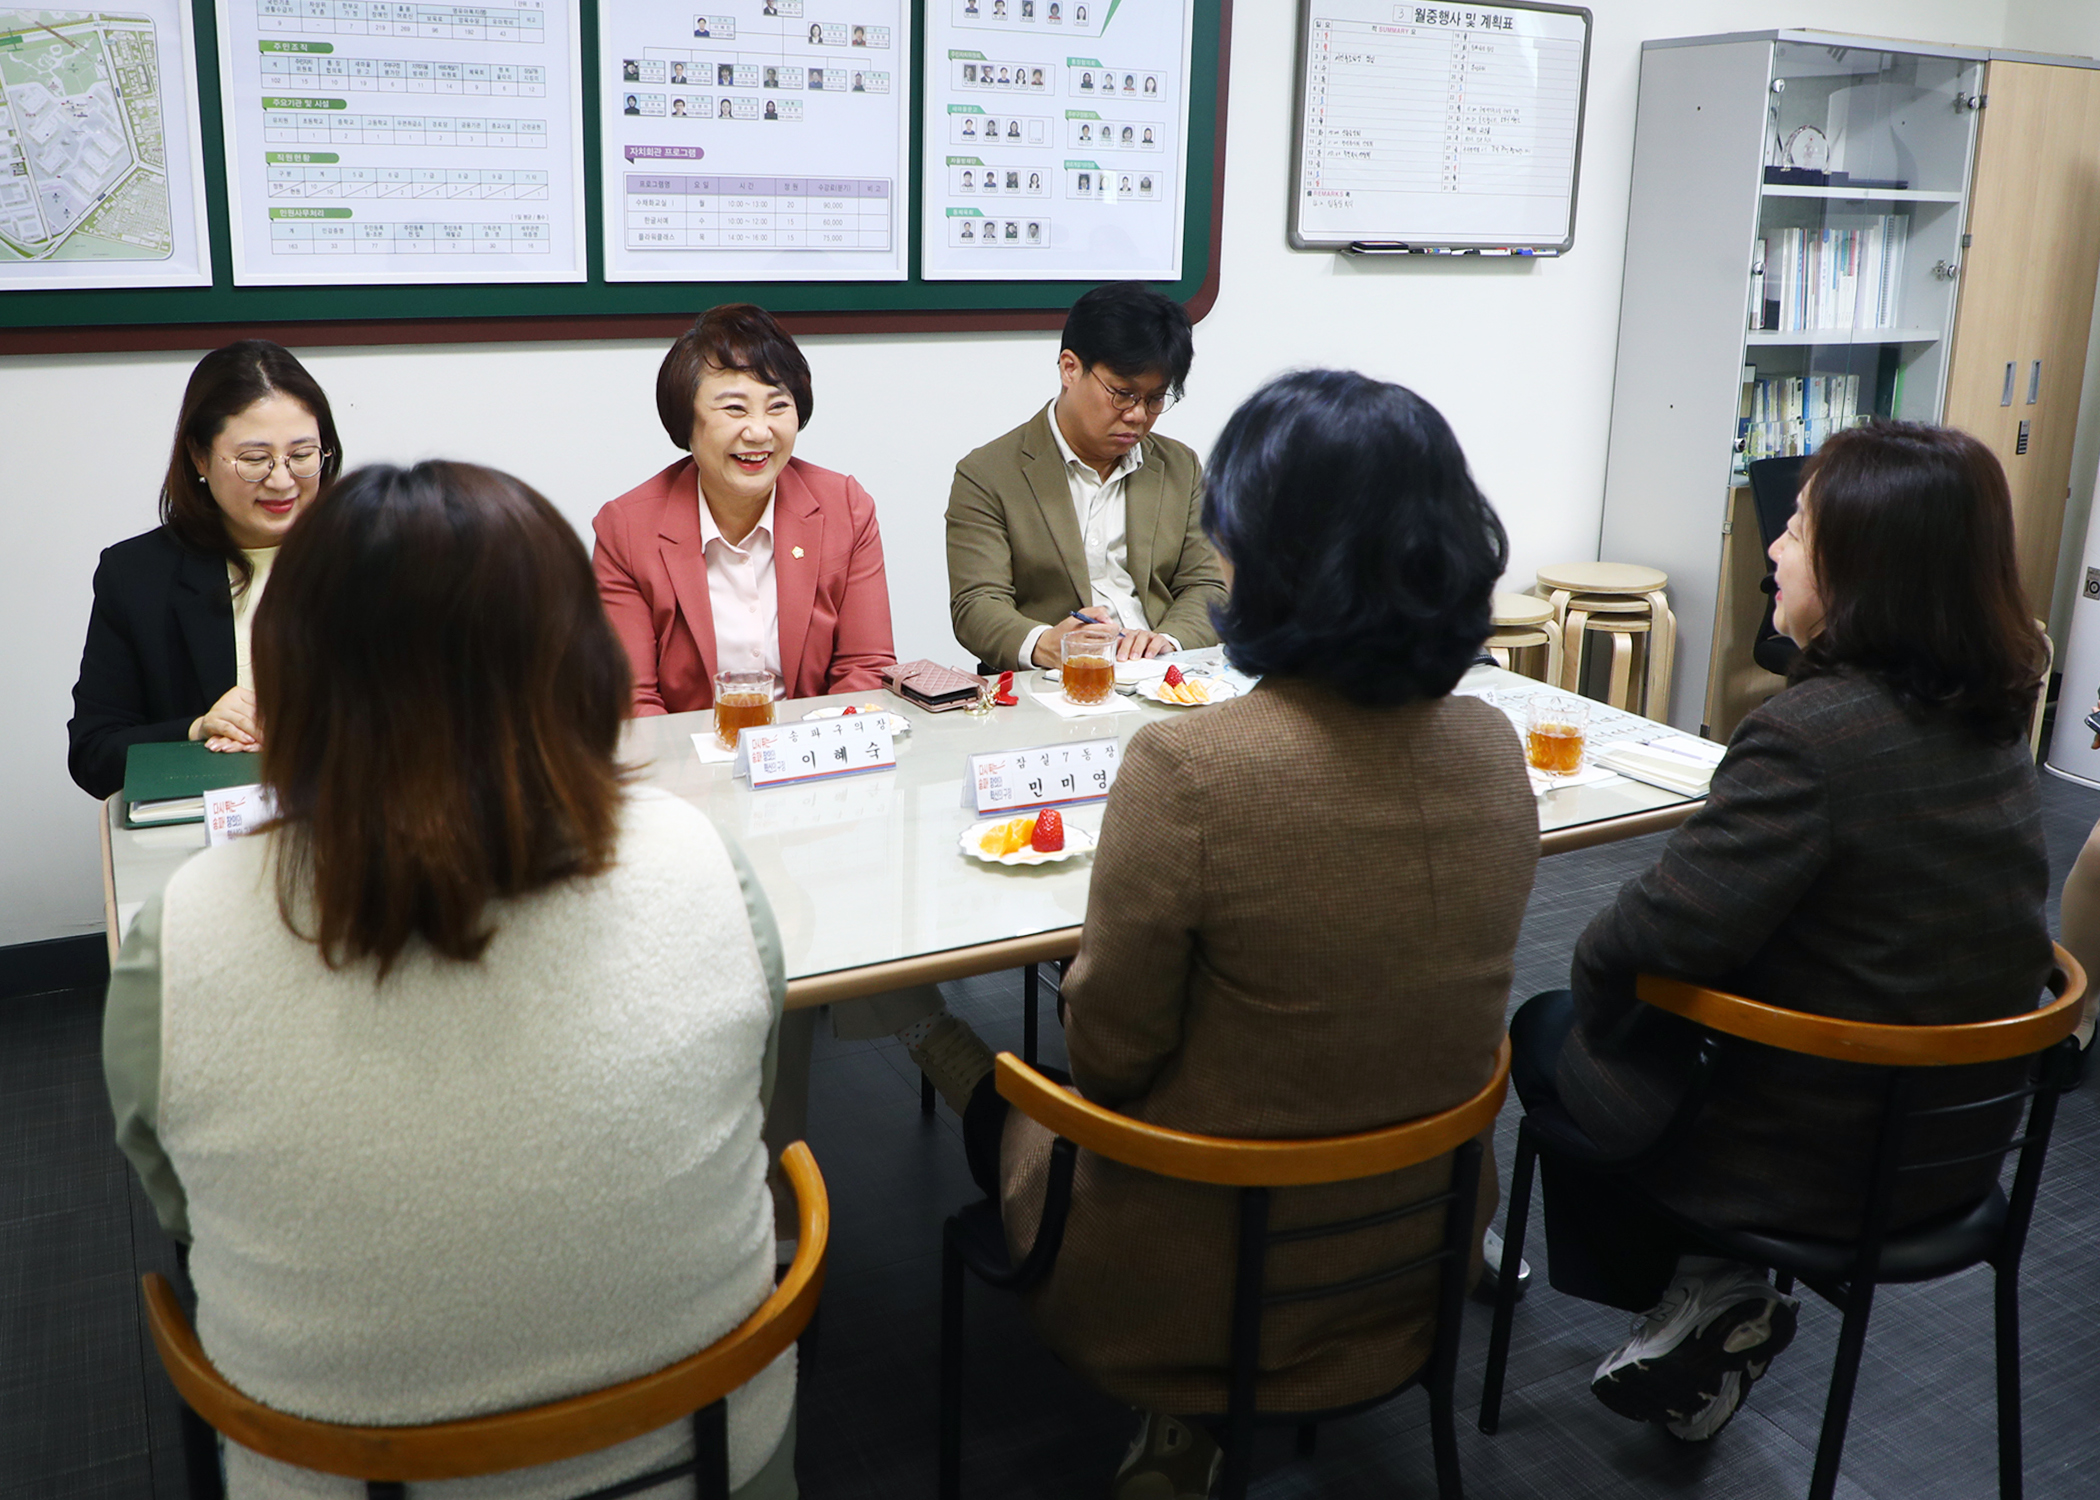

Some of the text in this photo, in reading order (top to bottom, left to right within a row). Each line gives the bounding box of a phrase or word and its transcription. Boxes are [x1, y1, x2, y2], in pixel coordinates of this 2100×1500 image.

[1397, 8, 1404, 19] 3
[1414, 8, 1513, 30] 월중행사 및 계획표
[274, 42, 308, 51] 주민조직
[314, 100, 330, 108] 시설
[630, 147, 696, 157] 자치회관 프로그램
[277, 154, 310, 162] 직원현황
[280, 209, 324, 217] 민원사무처리
